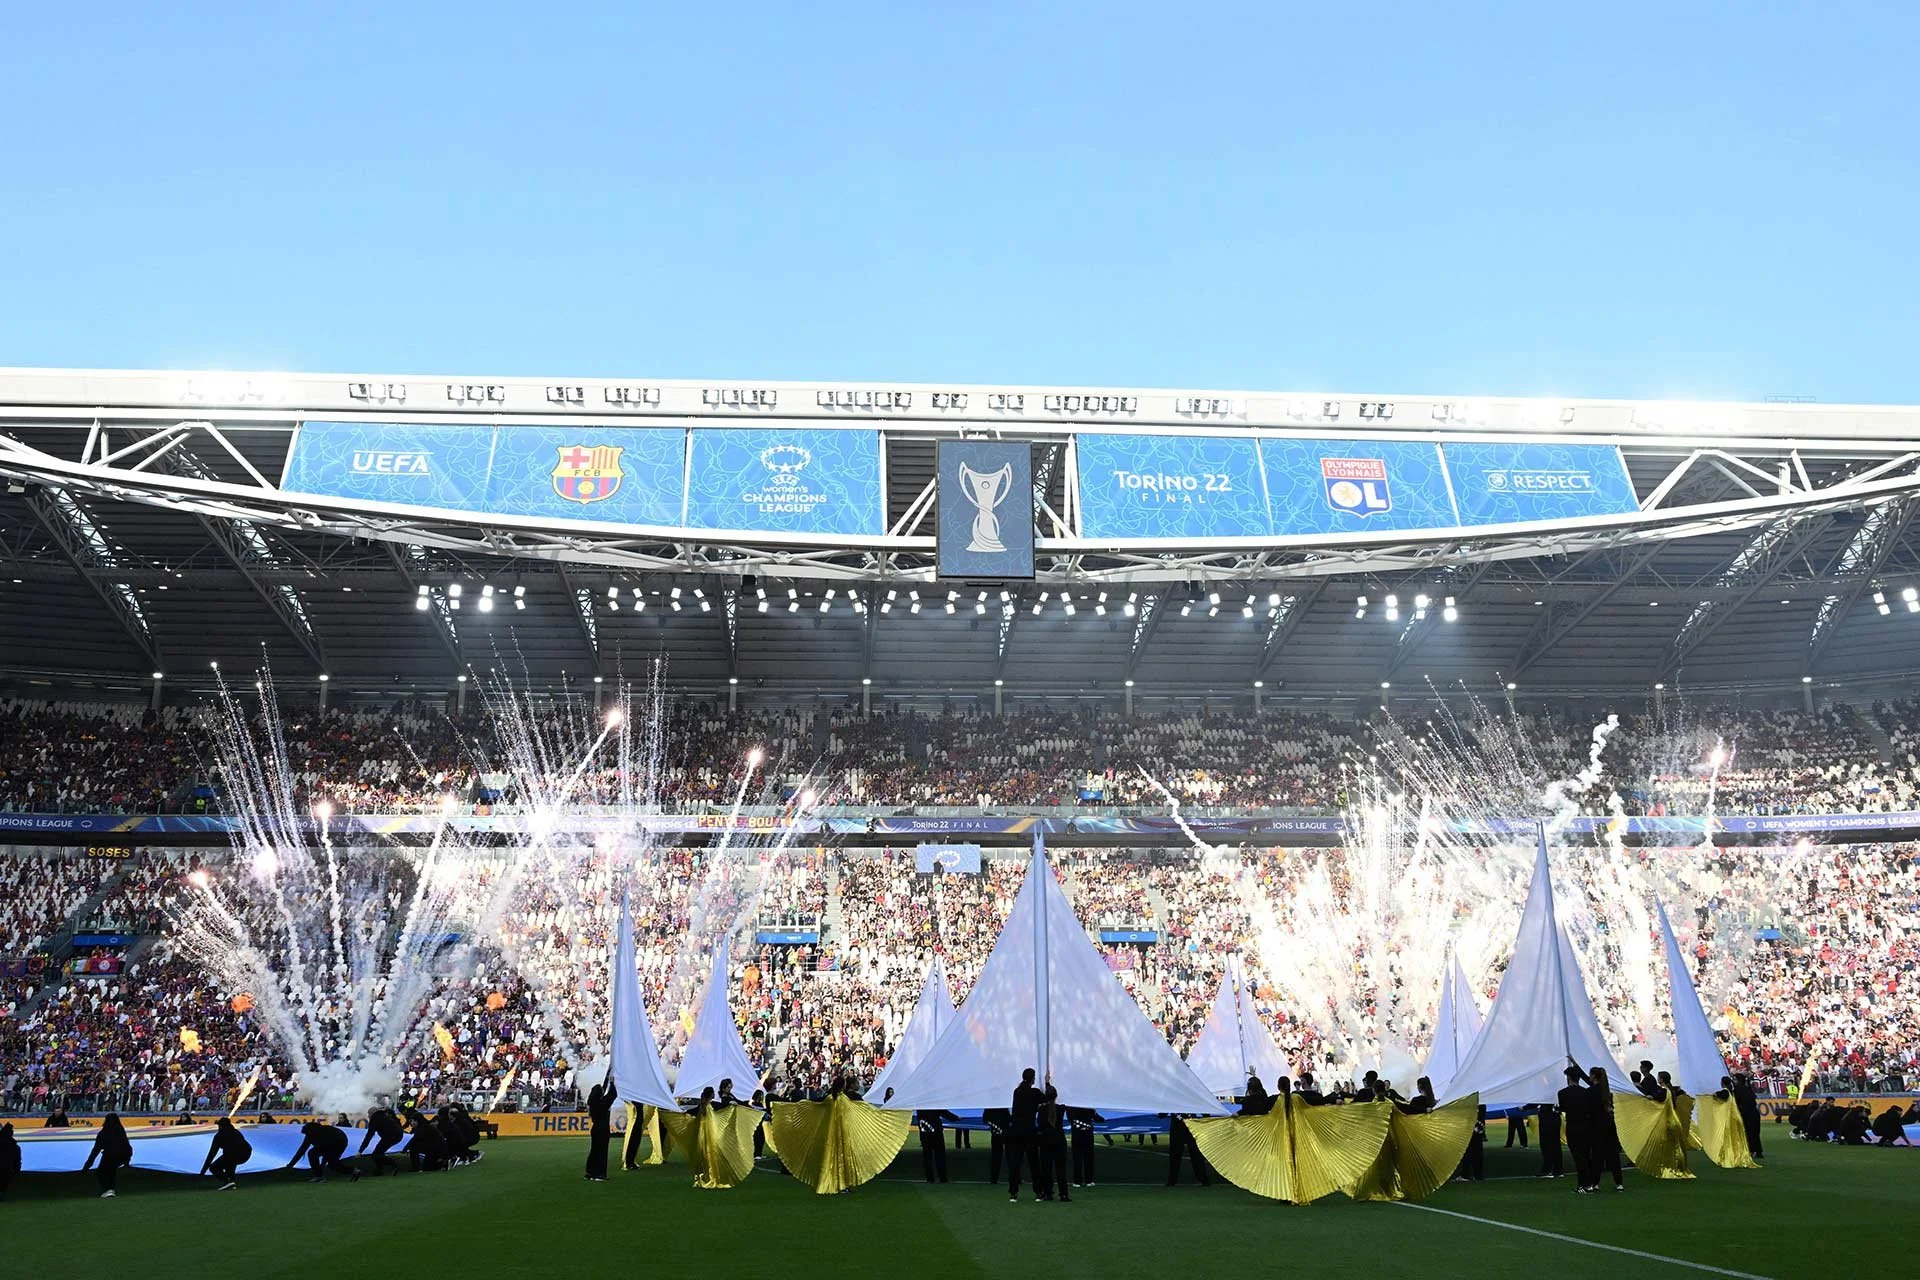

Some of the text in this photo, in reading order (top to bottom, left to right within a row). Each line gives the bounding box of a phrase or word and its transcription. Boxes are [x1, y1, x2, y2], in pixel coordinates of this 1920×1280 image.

[352, 453, 429, 472] UEFA
[1326, 461, 1381, 470] OLYMPIQUE
[1327, 469, 1382, 477] LYONNAIS
[1203, 473, 1232, 491] 22
[1513, 475, 1591, 489] RESPECT
[742, 494, 827, 503] CHAMPIONS
[1142, 493, 1206, 504] FINAL
[1331, 481, 1387, 508] OL
[759, 504, 812, 513] LEAGUE
[36, 819, 73, 828] LEAGUE
[940, 820, 949, 829] 22
[953, 821, 989, 829] FINAL
[1763, 815, 1920, 829] UEFA WOMEN'S CHAMPIONS LEAGU
[88, 846, 131, 858] SOSES
[532, 1116, 590, 1131] THERE
